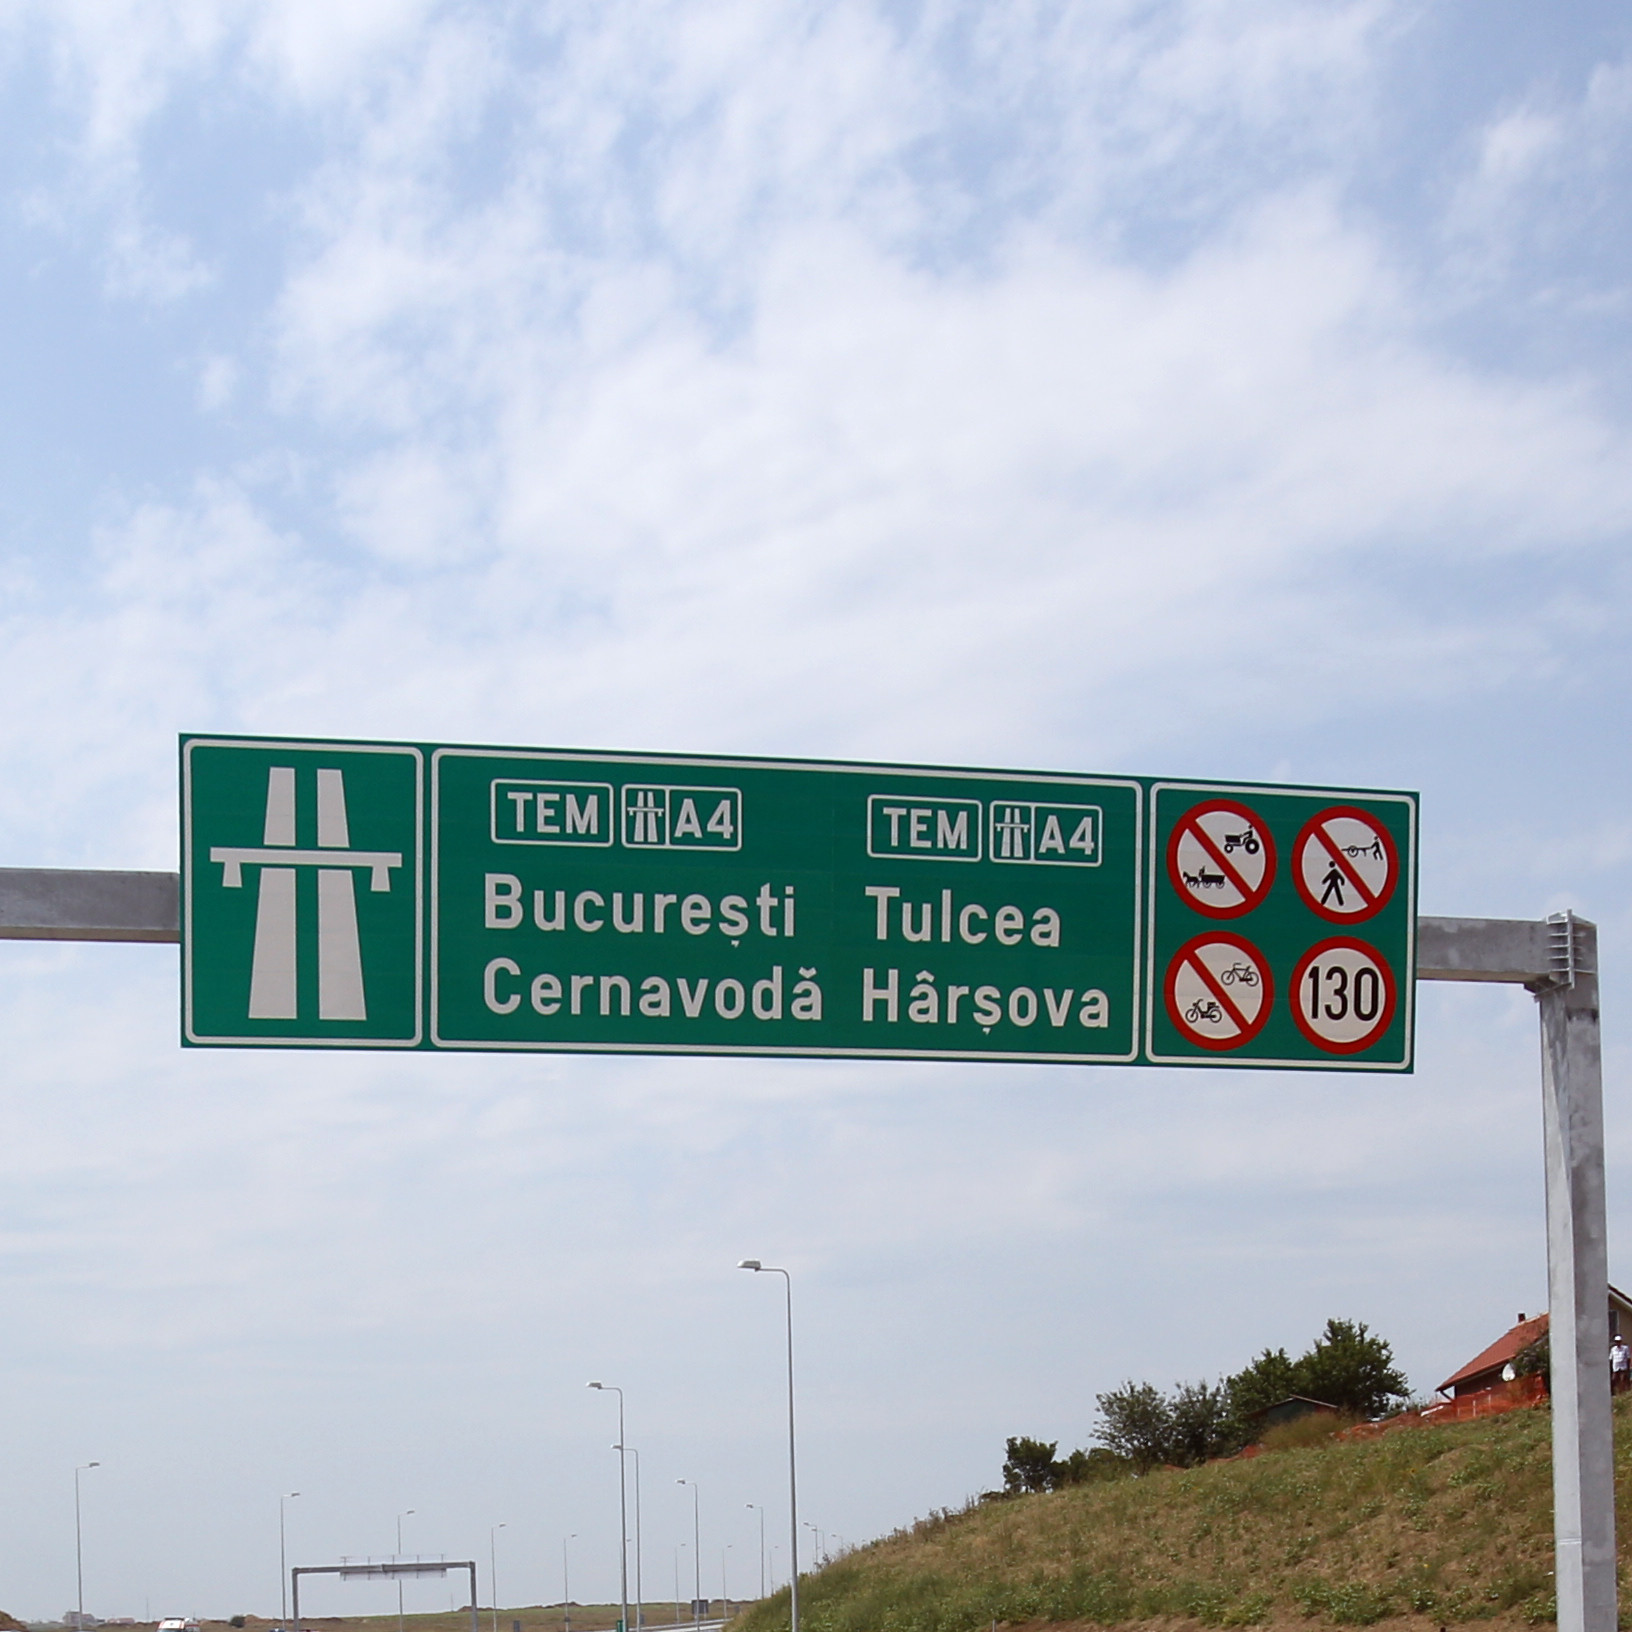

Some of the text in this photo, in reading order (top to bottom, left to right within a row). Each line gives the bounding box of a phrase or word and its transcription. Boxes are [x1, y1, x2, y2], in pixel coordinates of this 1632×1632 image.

[508, 790, 599, 835] TEM
[675, 797, 734, 840] A4
[883, 806, 968, 850] TEM
[1039, 814, 1095, 855] A4
[484, 872, 796, 947] București
[864, 885, 1061, 948] Tulcea
[483, 957, 823, 1022] Cernavodă
[862, 967, 1109, 1035] Hârșova
[1308, 965, 1379, 1022] 130
